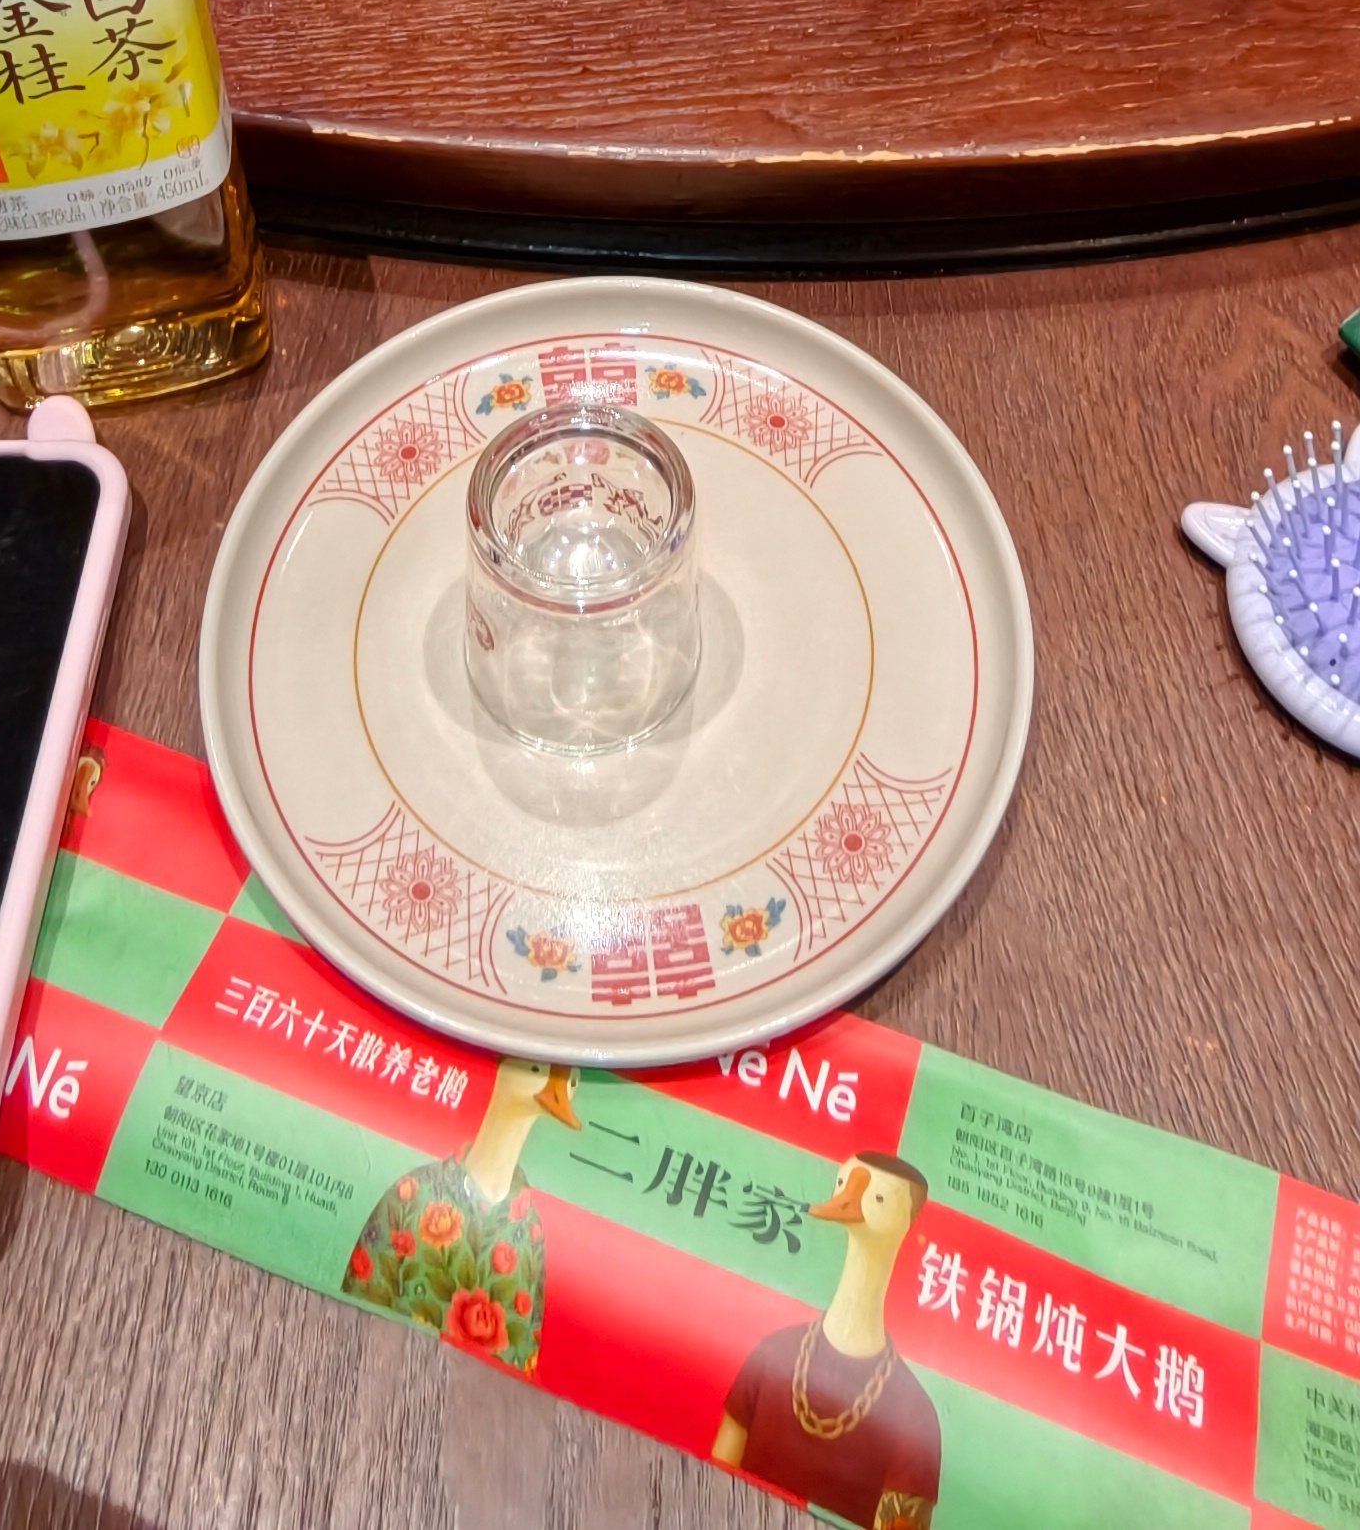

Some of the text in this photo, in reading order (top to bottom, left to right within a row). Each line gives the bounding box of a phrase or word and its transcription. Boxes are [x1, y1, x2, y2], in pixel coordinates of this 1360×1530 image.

[215, 975, 470, 1110] 三百六十天散养老鹅
[568, 1120, 811, 1255] 二胖家
[916, 1241, 1207, 1429] 铁锅炖大鹅
